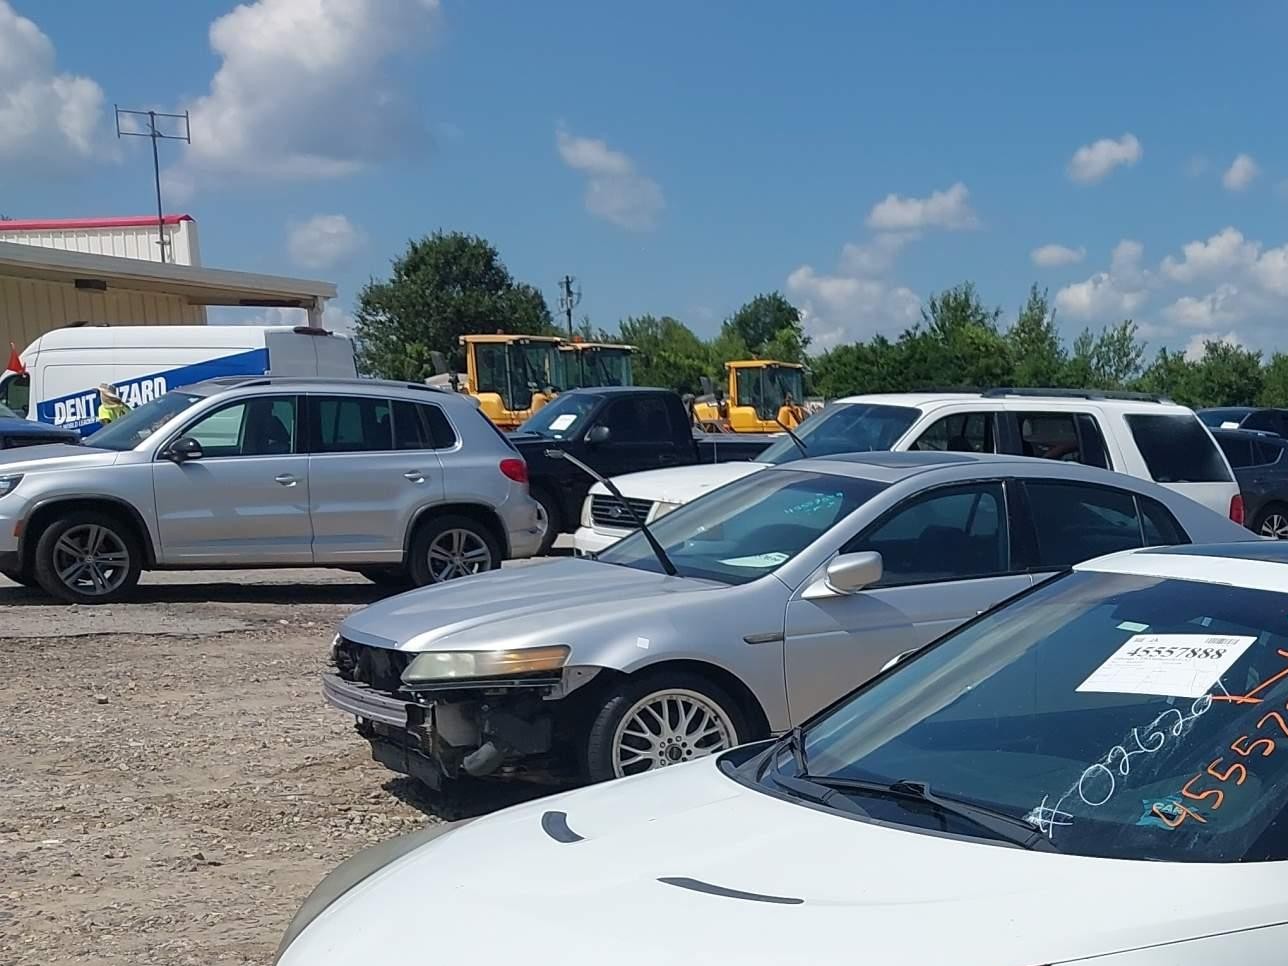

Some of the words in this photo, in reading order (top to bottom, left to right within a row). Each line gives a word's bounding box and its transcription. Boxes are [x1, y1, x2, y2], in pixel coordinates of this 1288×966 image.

[54, 393, 97, 426] DENT
[116, 377, 167, 410] ZARD
[1127, 646, 1227, 660] 45557888
